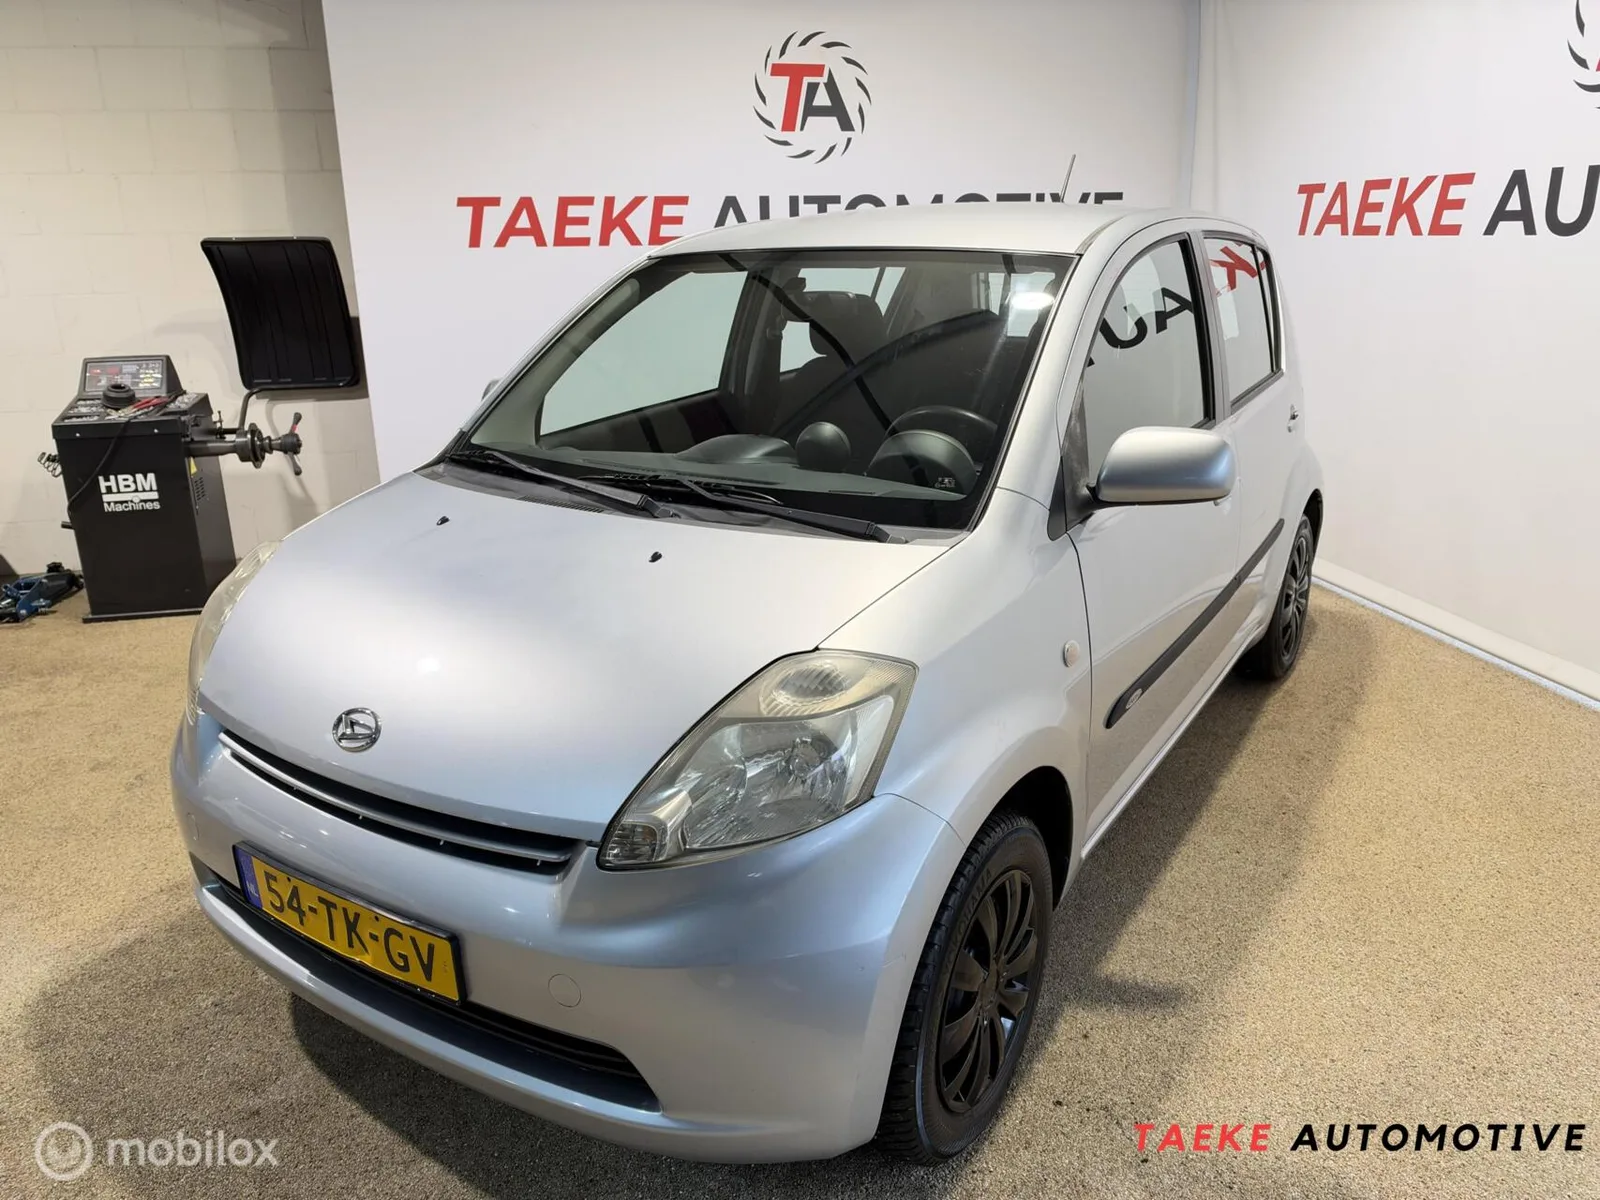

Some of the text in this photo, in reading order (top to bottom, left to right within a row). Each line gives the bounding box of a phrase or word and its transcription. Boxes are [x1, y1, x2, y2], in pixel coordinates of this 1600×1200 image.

[770, 63, 855, 132] TA
[457, 196, 688, 248] TAEKE
[1297, 173, 1475, 236] TAEKE
[98, 472, 158, 493] HBM
[103, 501, 161, 512] Machines
[264, 870, 436, 983] 54-TK-GV
